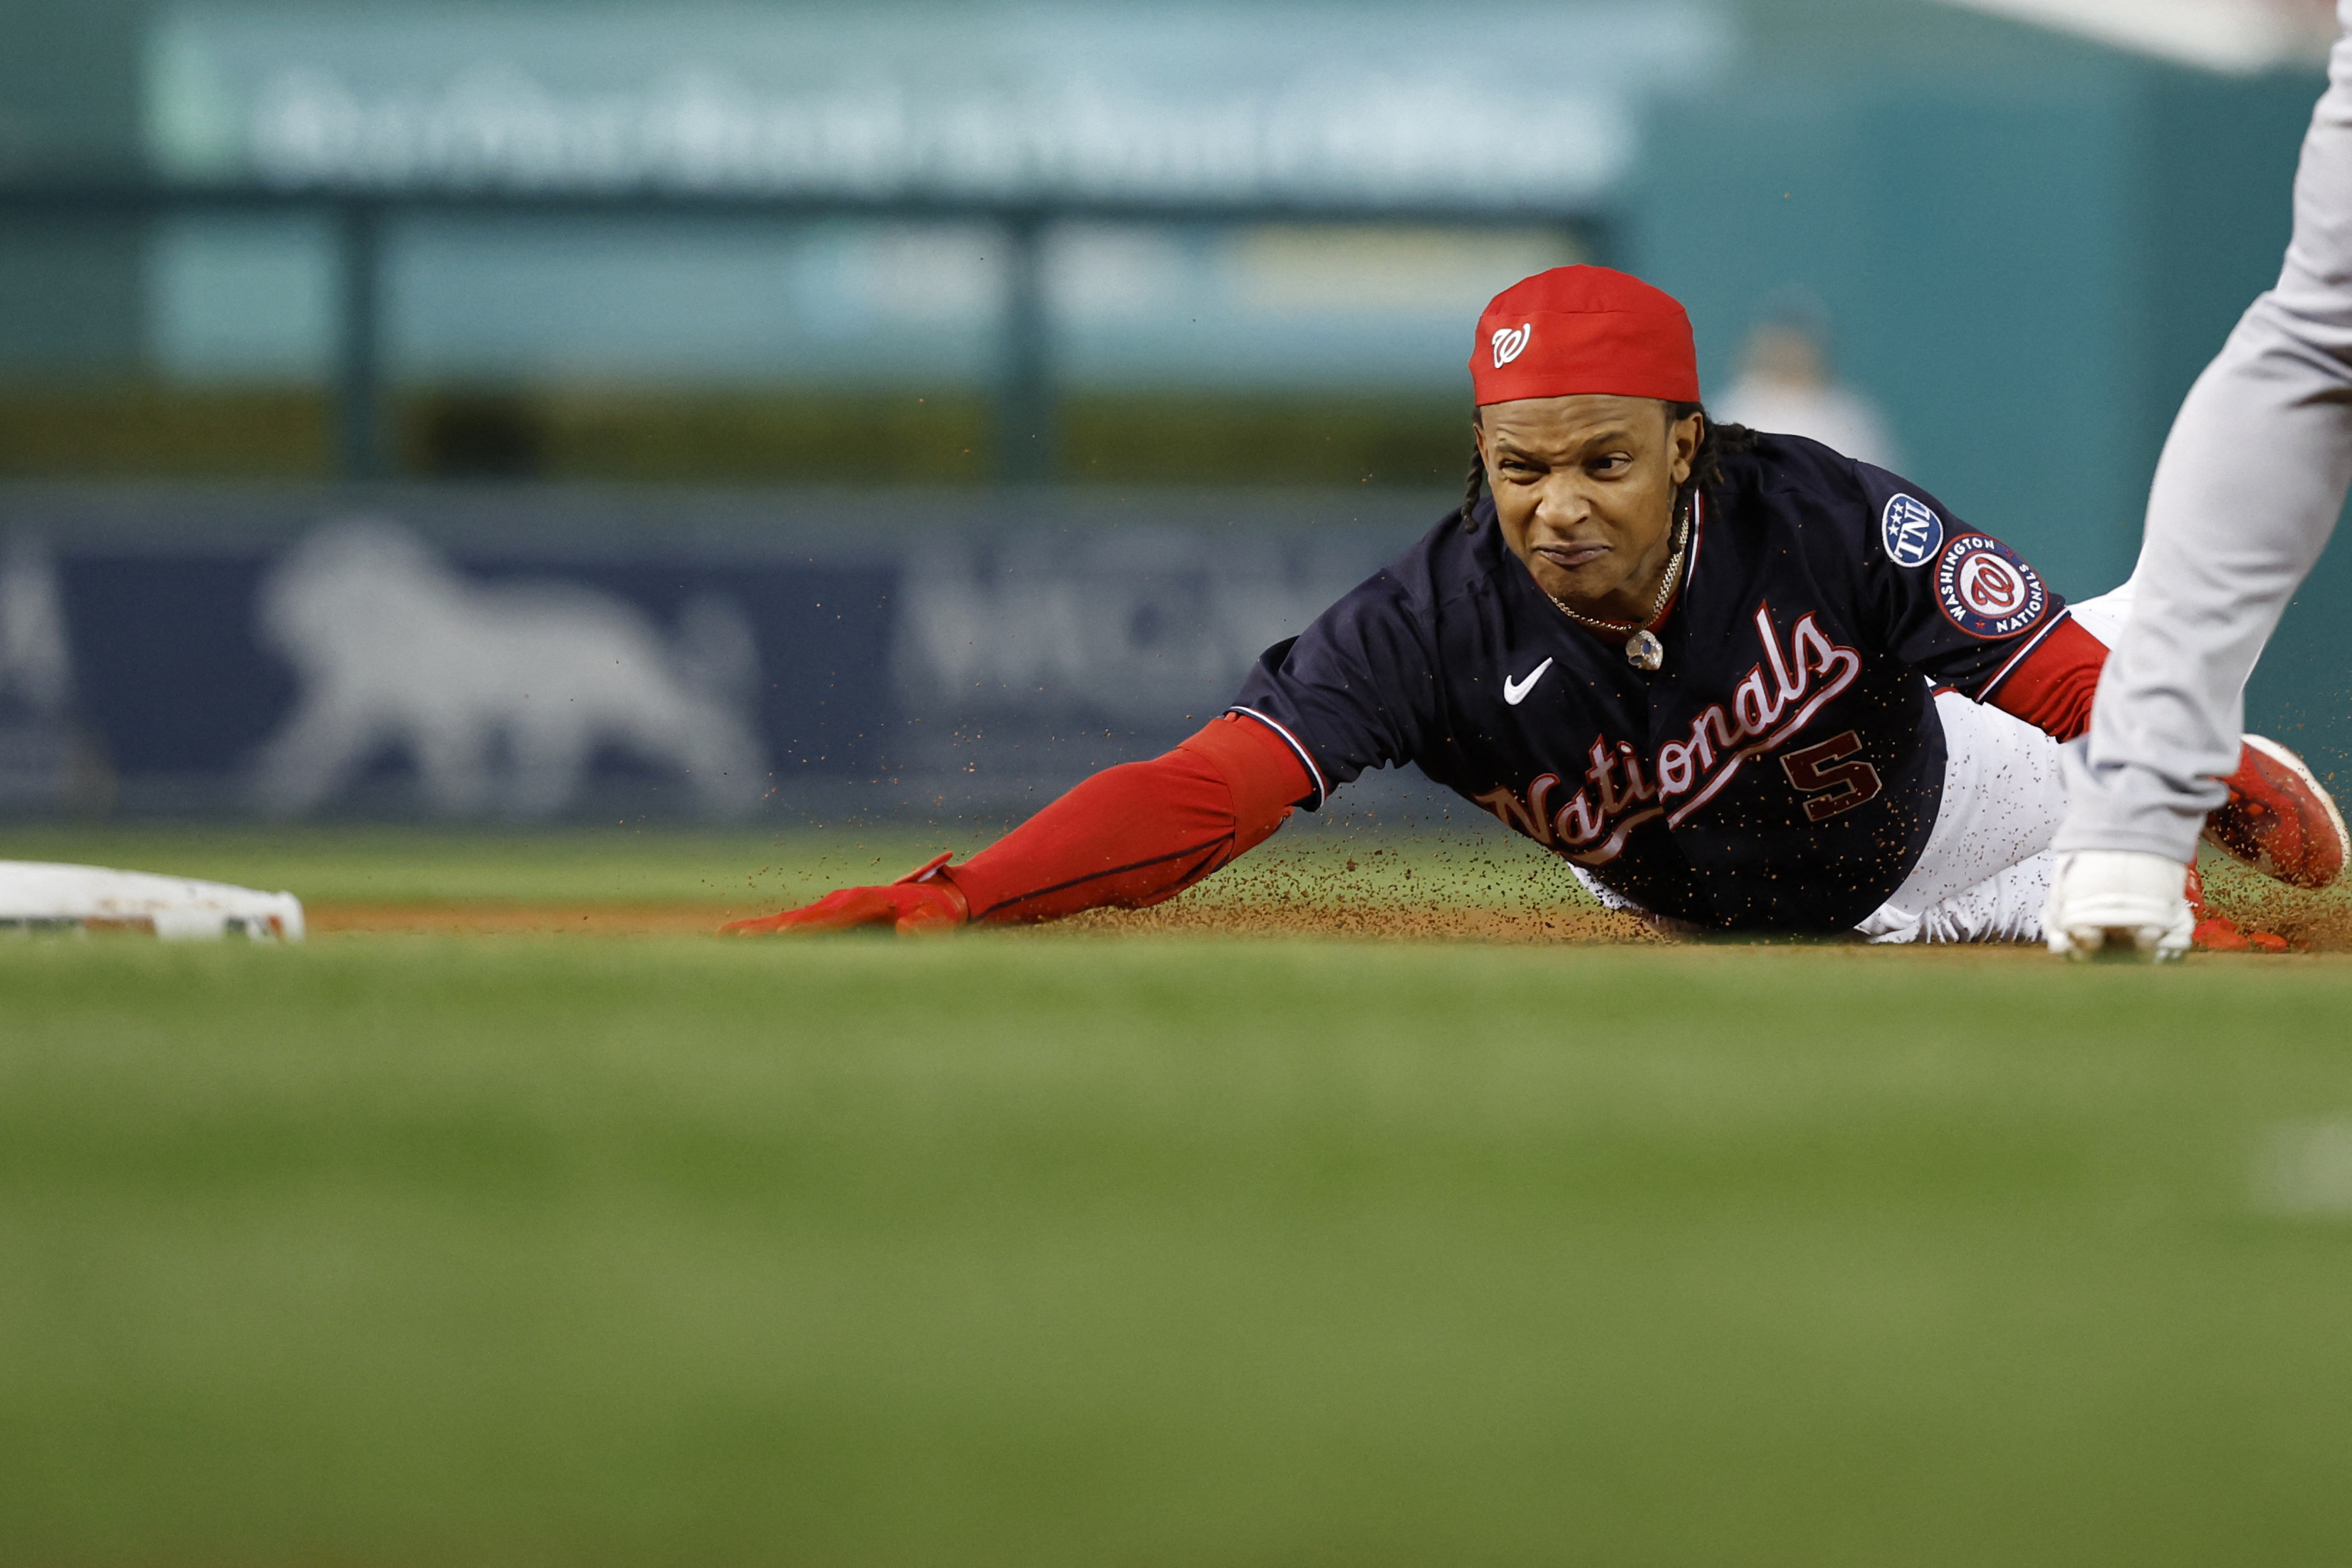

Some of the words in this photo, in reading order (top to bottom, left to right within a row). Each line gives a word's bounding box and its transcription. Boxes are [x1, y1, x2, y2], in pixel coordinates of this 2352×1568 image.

[1492, 323, 1531, 369] W
[1894, 501, 1930, 560] TNL
[1940, 537, 1995, 622] WASHINGTON
[1971, 556, 2014, 607] W
[1996, 563, 2043, 633] NATIONALS
[1473, 600, 1862, 864] Nationals
[1780, 730, 1882, 822] 5
